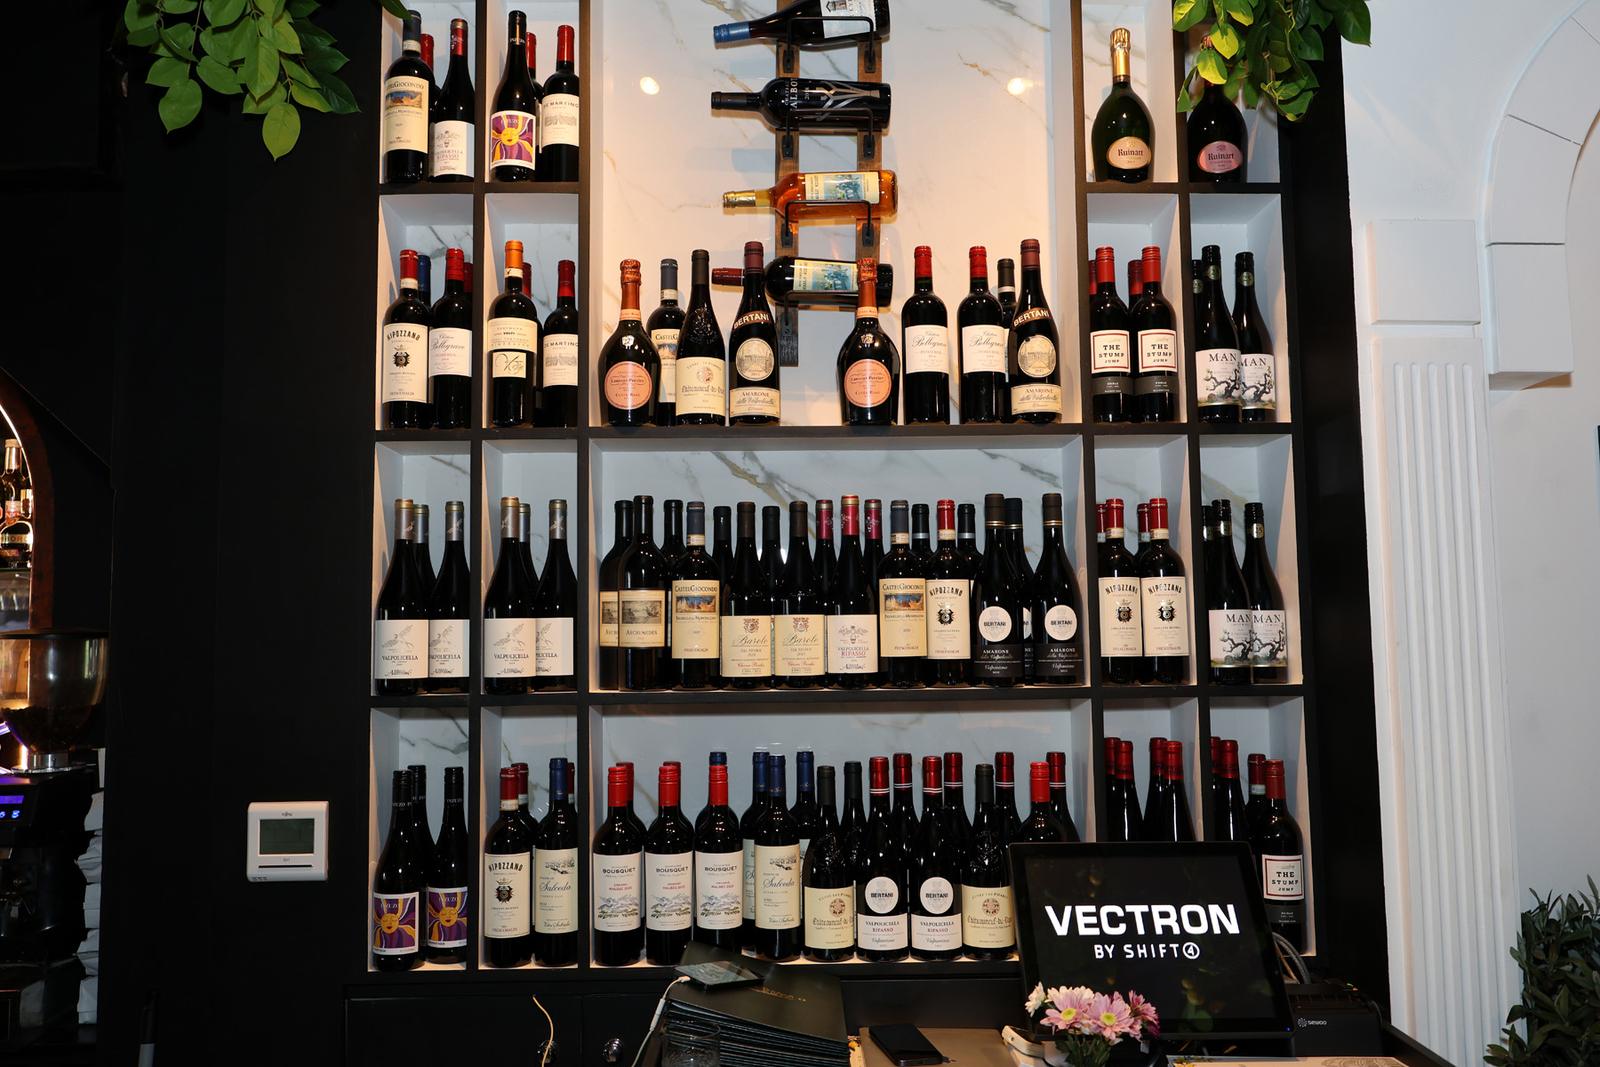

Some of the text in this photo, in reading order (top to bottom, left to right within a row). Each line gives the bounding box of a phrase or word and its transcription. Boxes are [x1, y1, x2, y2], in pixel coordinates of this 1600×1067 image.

[1117, 149, 1143, 157] Ruinart
[1207, 153, 1234, 161] Ruinart
[733, 312, 770, 329] BERTANI
[1013, 309, 1050, 327] BERTANI
[1209, 352, 1237, 362] MAN
[1226, 613, 1252, 624] MAN
[1253, 613, 1281, 624] MAN
[488, 862, 524, 872] NIPOZZANO
[655, 866, 689, 874] BOUSQUET
[870, 891, 894, 899] BERTANI
[1045, 904, 1240, 936] VECTRON
[1094, 943, 1115, 959] BY
